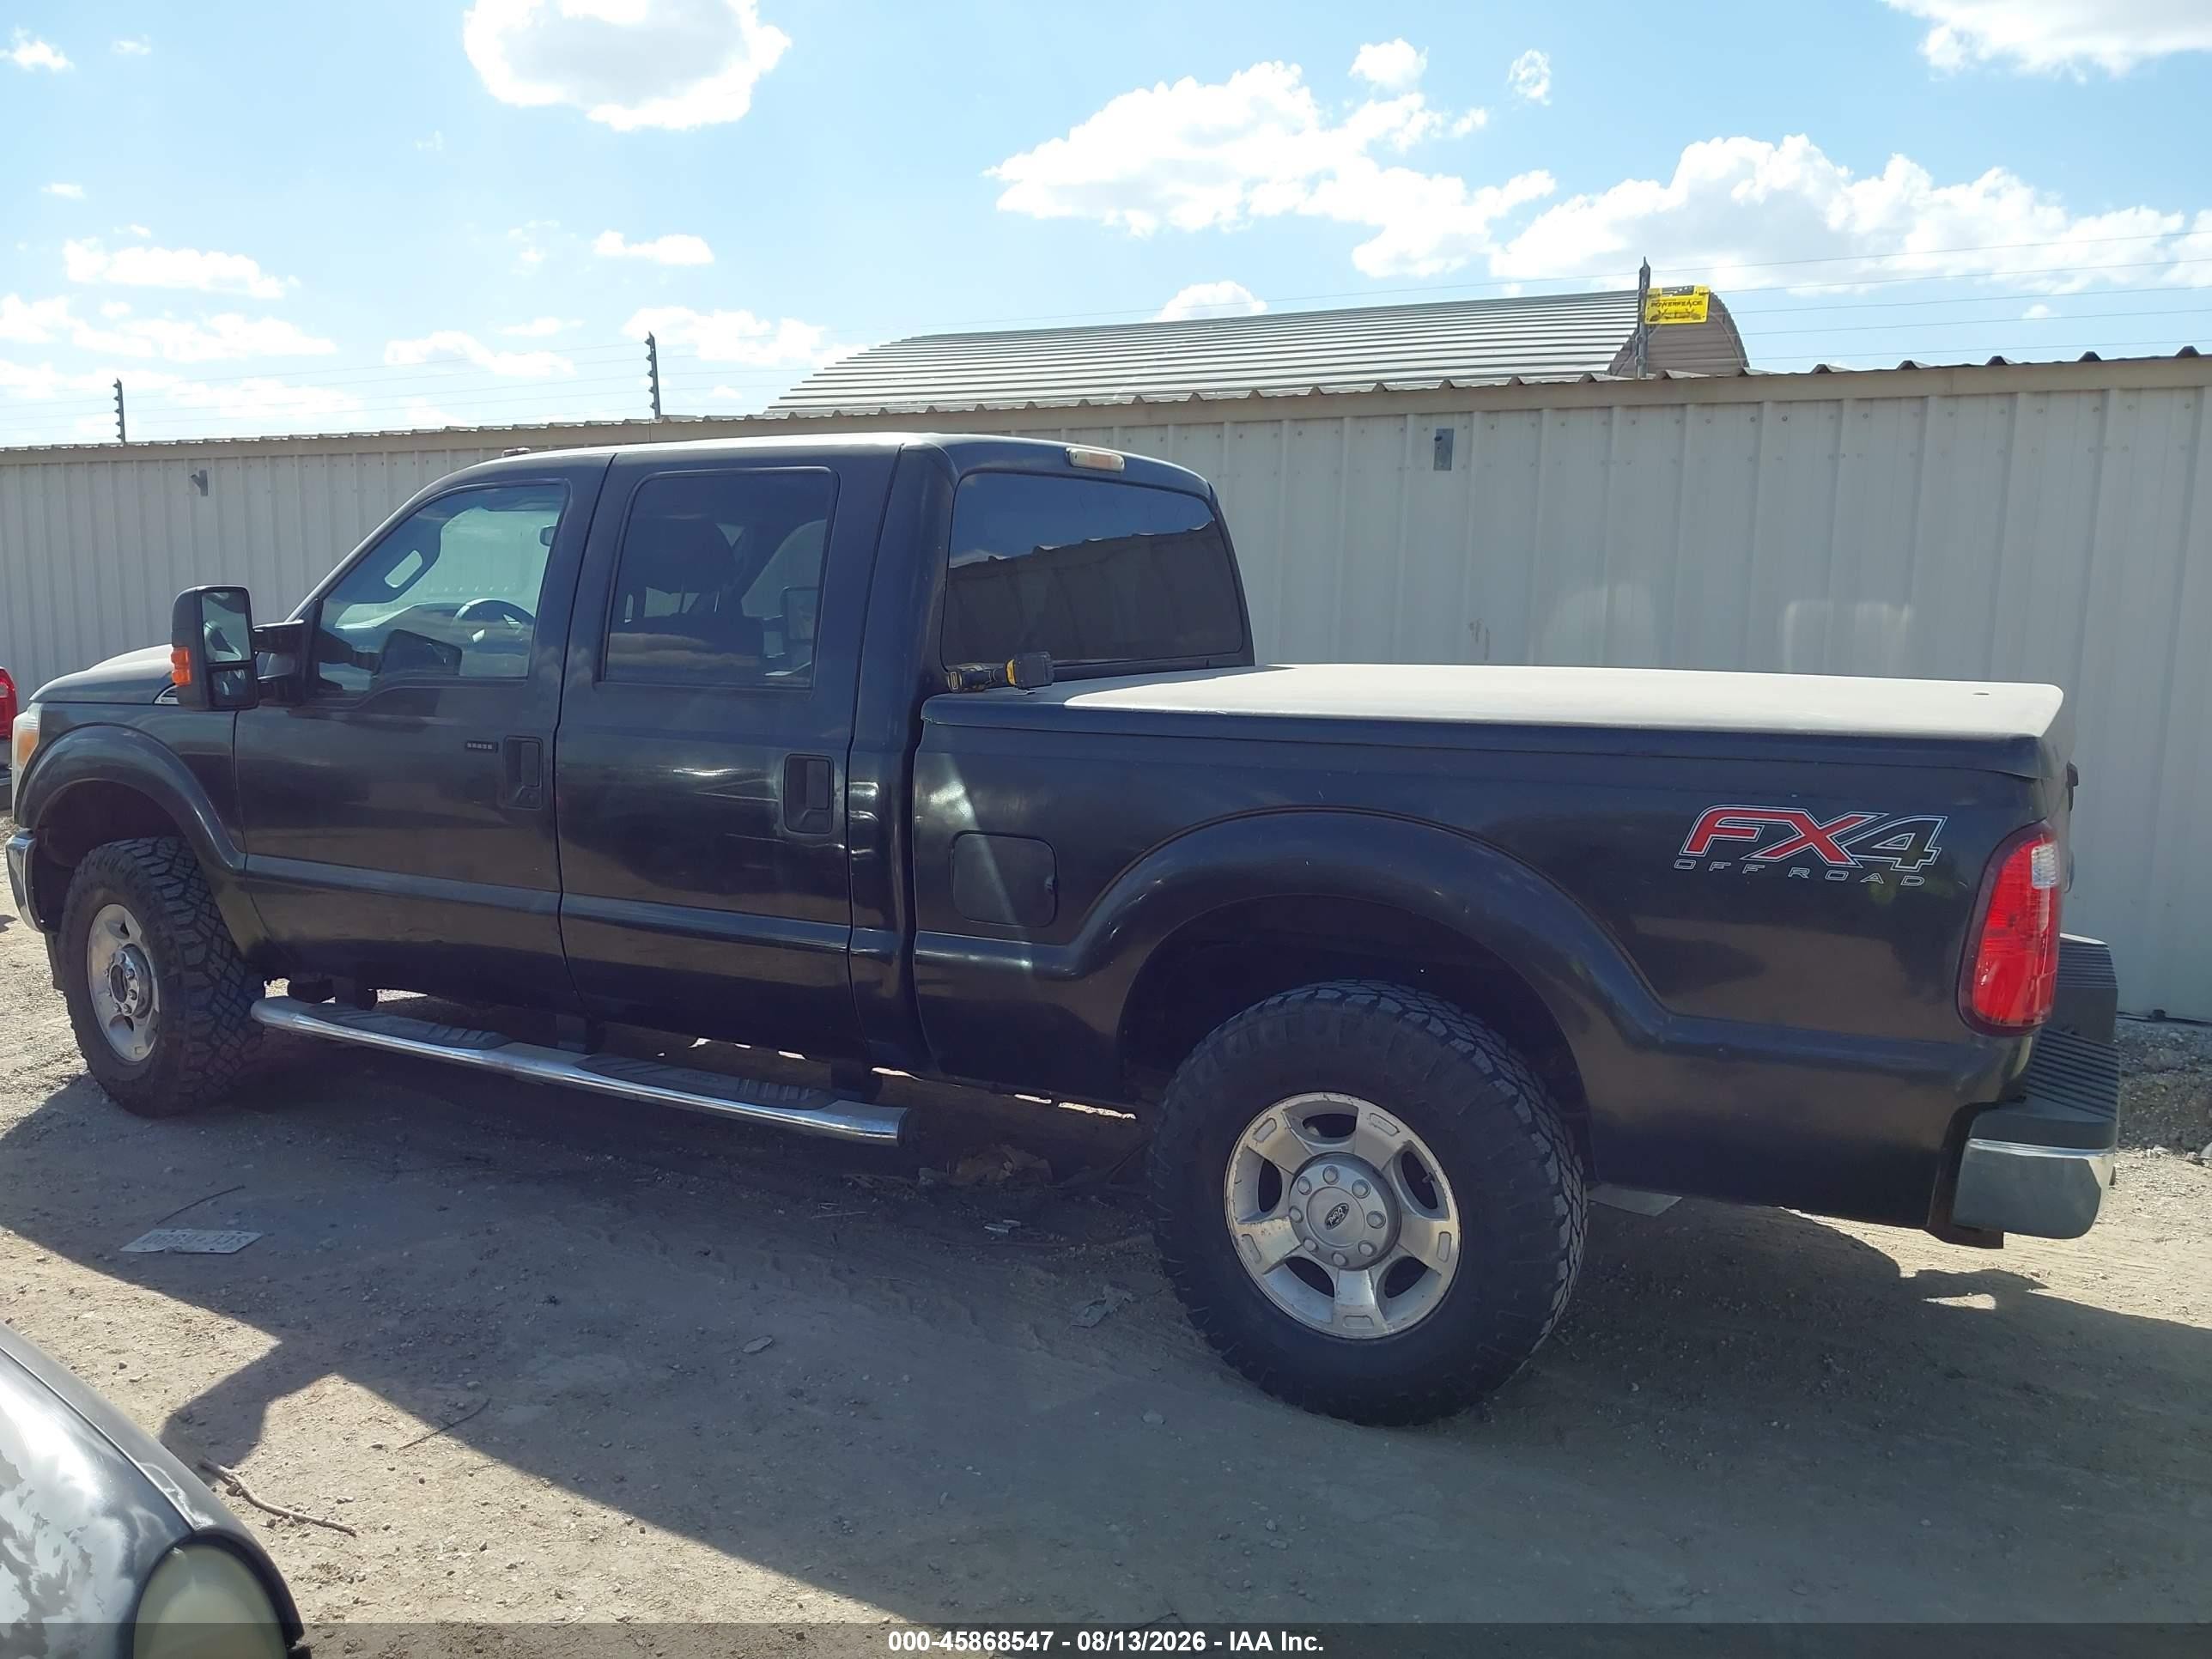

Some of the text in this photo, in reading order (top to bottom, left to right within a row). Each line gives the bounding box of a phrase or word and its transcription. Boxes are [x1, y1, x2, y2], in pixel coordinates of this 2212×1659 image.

[1678, 804, 1948, 872] FX4
[1674, 859, 1926, 887] OFF ROAD
